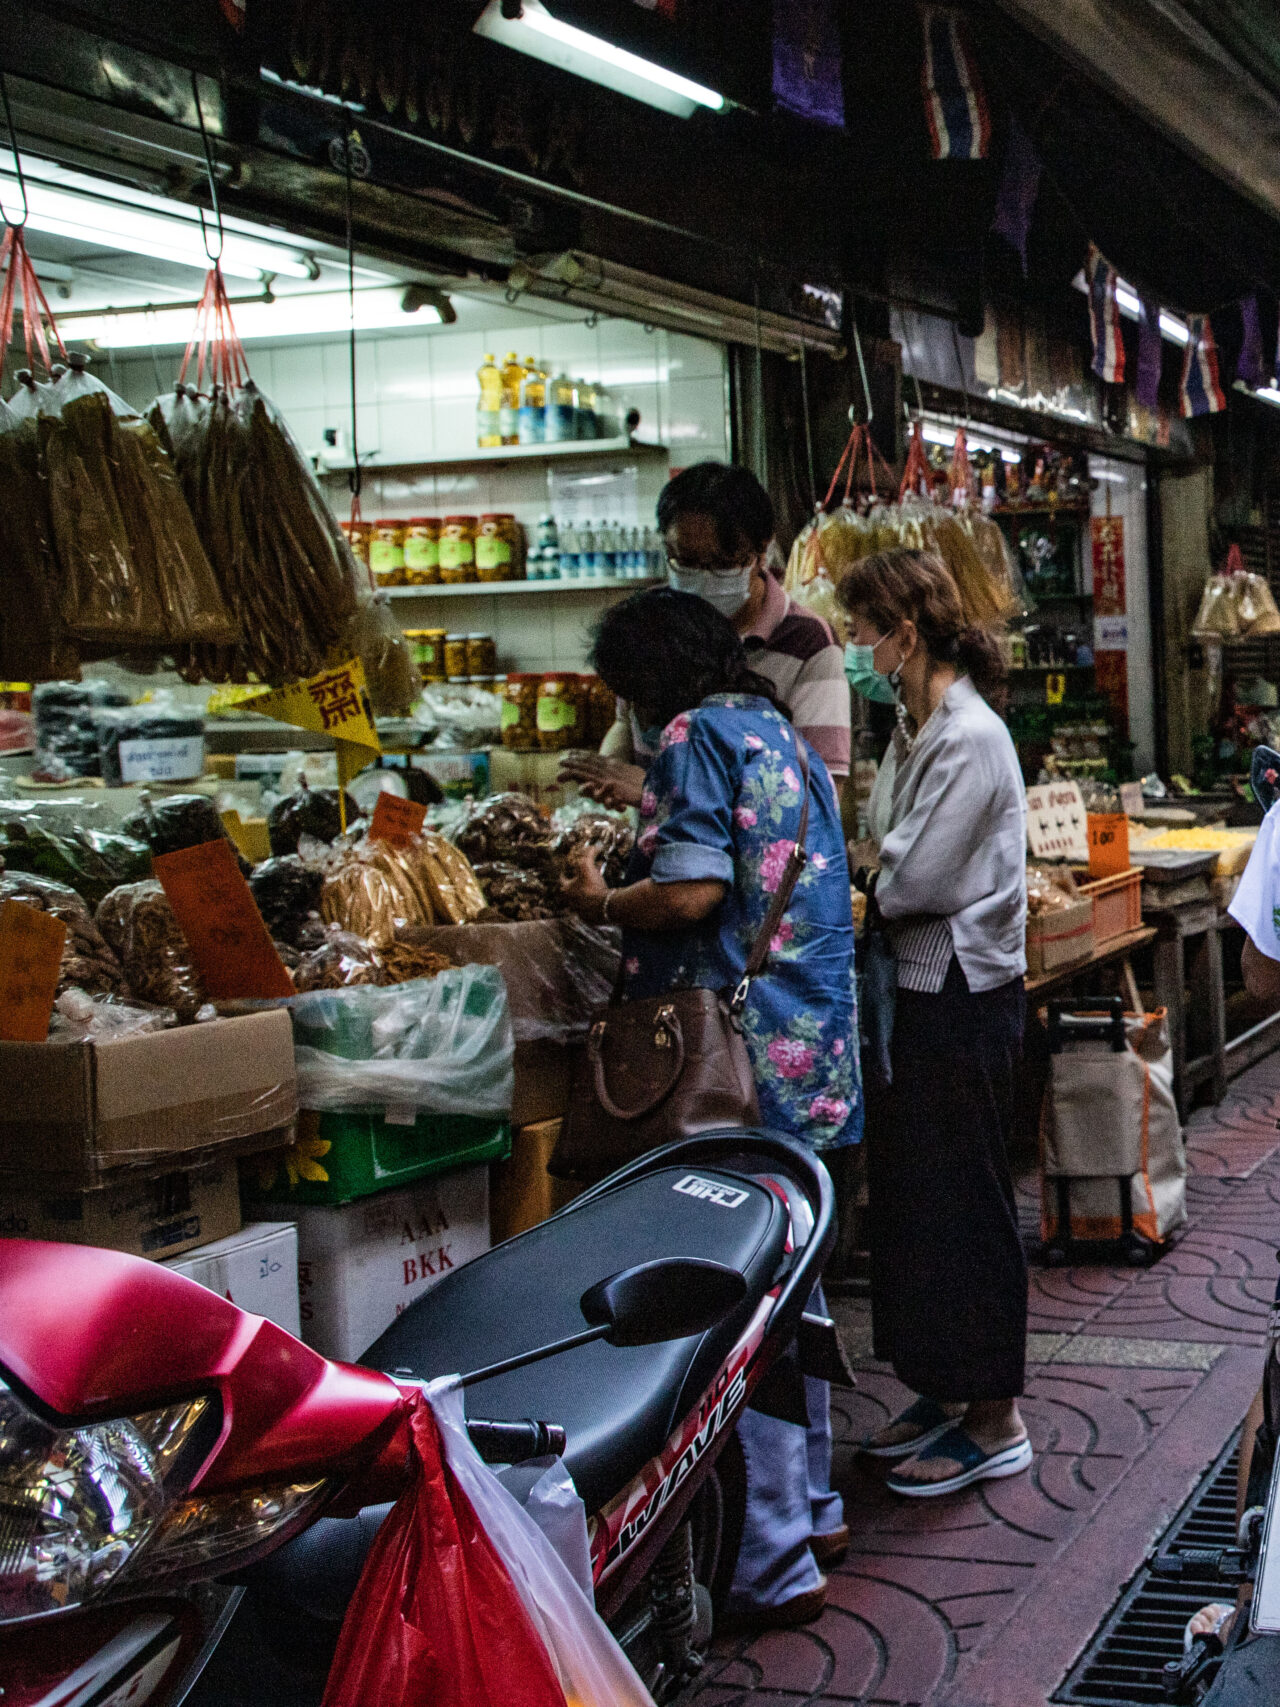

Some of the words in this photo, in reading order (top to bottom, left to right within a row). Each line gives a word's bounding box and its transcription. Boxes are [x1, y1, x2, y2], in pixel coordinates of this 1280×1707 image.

[400, 1209, 449, 1246] AAA
[402, 1243, 454, 1286] BKK
[618, 1365, 747, 1556] WAVE
